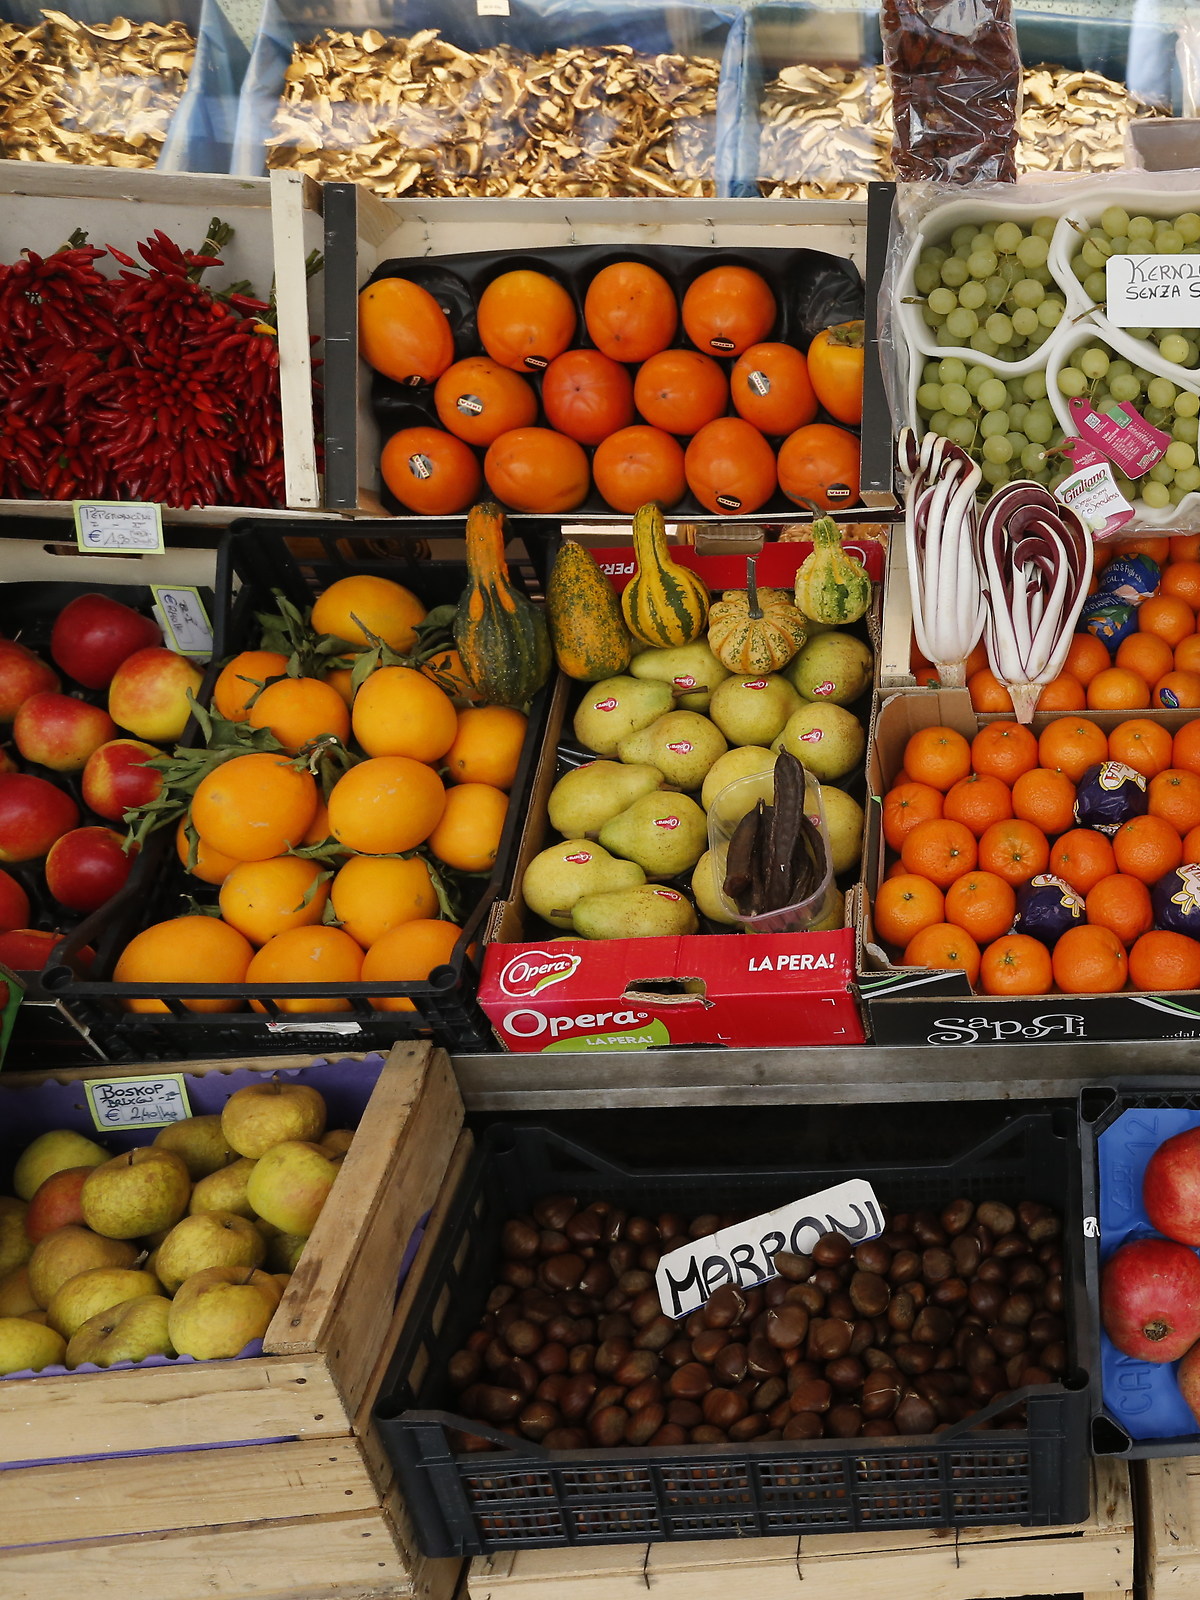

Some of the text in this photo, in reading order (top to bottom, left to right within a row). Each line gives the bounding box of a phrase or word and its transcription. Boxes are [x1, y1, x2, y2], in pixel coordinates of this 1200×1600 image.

[1125, 284, 1181, 300] SENZA
[1063, 469, 1107, 504] Giuliano
[748, 953, 836, 972] LA PERA!
[507, 958, 569, 987] Opera
[502, 1009, 637, 1038] Opera
[585, 1033, 654, 1046] LA PERA!
[95, 1083, 164, 1100] BOSKOP
[105, 1108, 120, 1122] €
[665, 1200, 882, 1316] MARRONI
